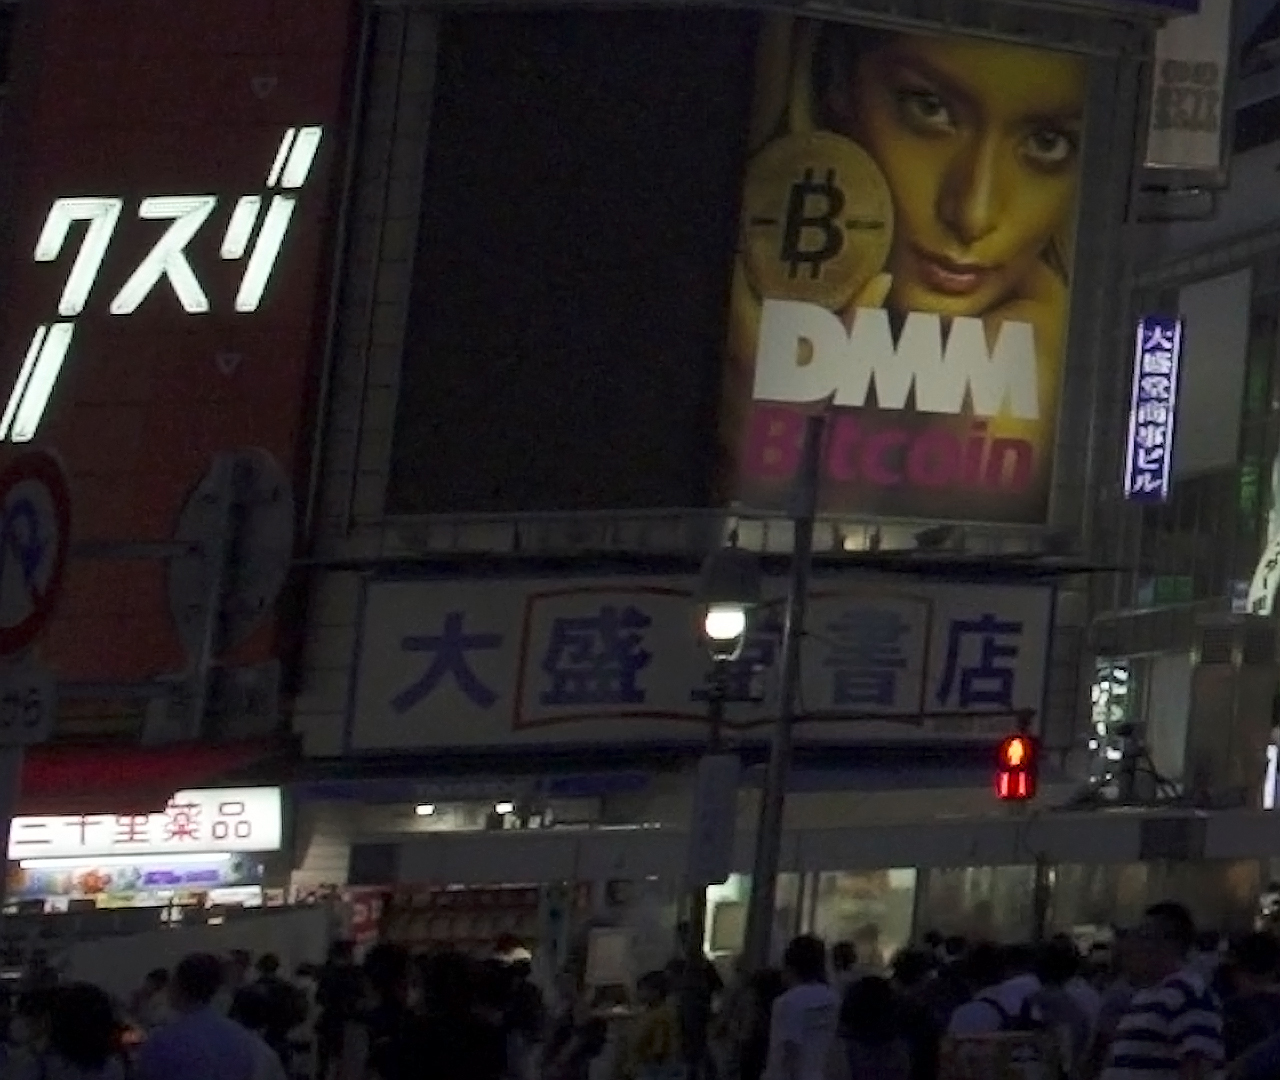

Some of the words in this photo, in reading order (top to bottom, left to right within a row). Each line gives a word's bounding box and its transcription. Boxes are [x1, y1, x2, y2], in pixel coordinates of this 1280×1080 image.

[34, 126, 323, 315] クスリ
[752, 298, 1040, 420] DMM
[748, 404, 1036, 493] Btcoin
